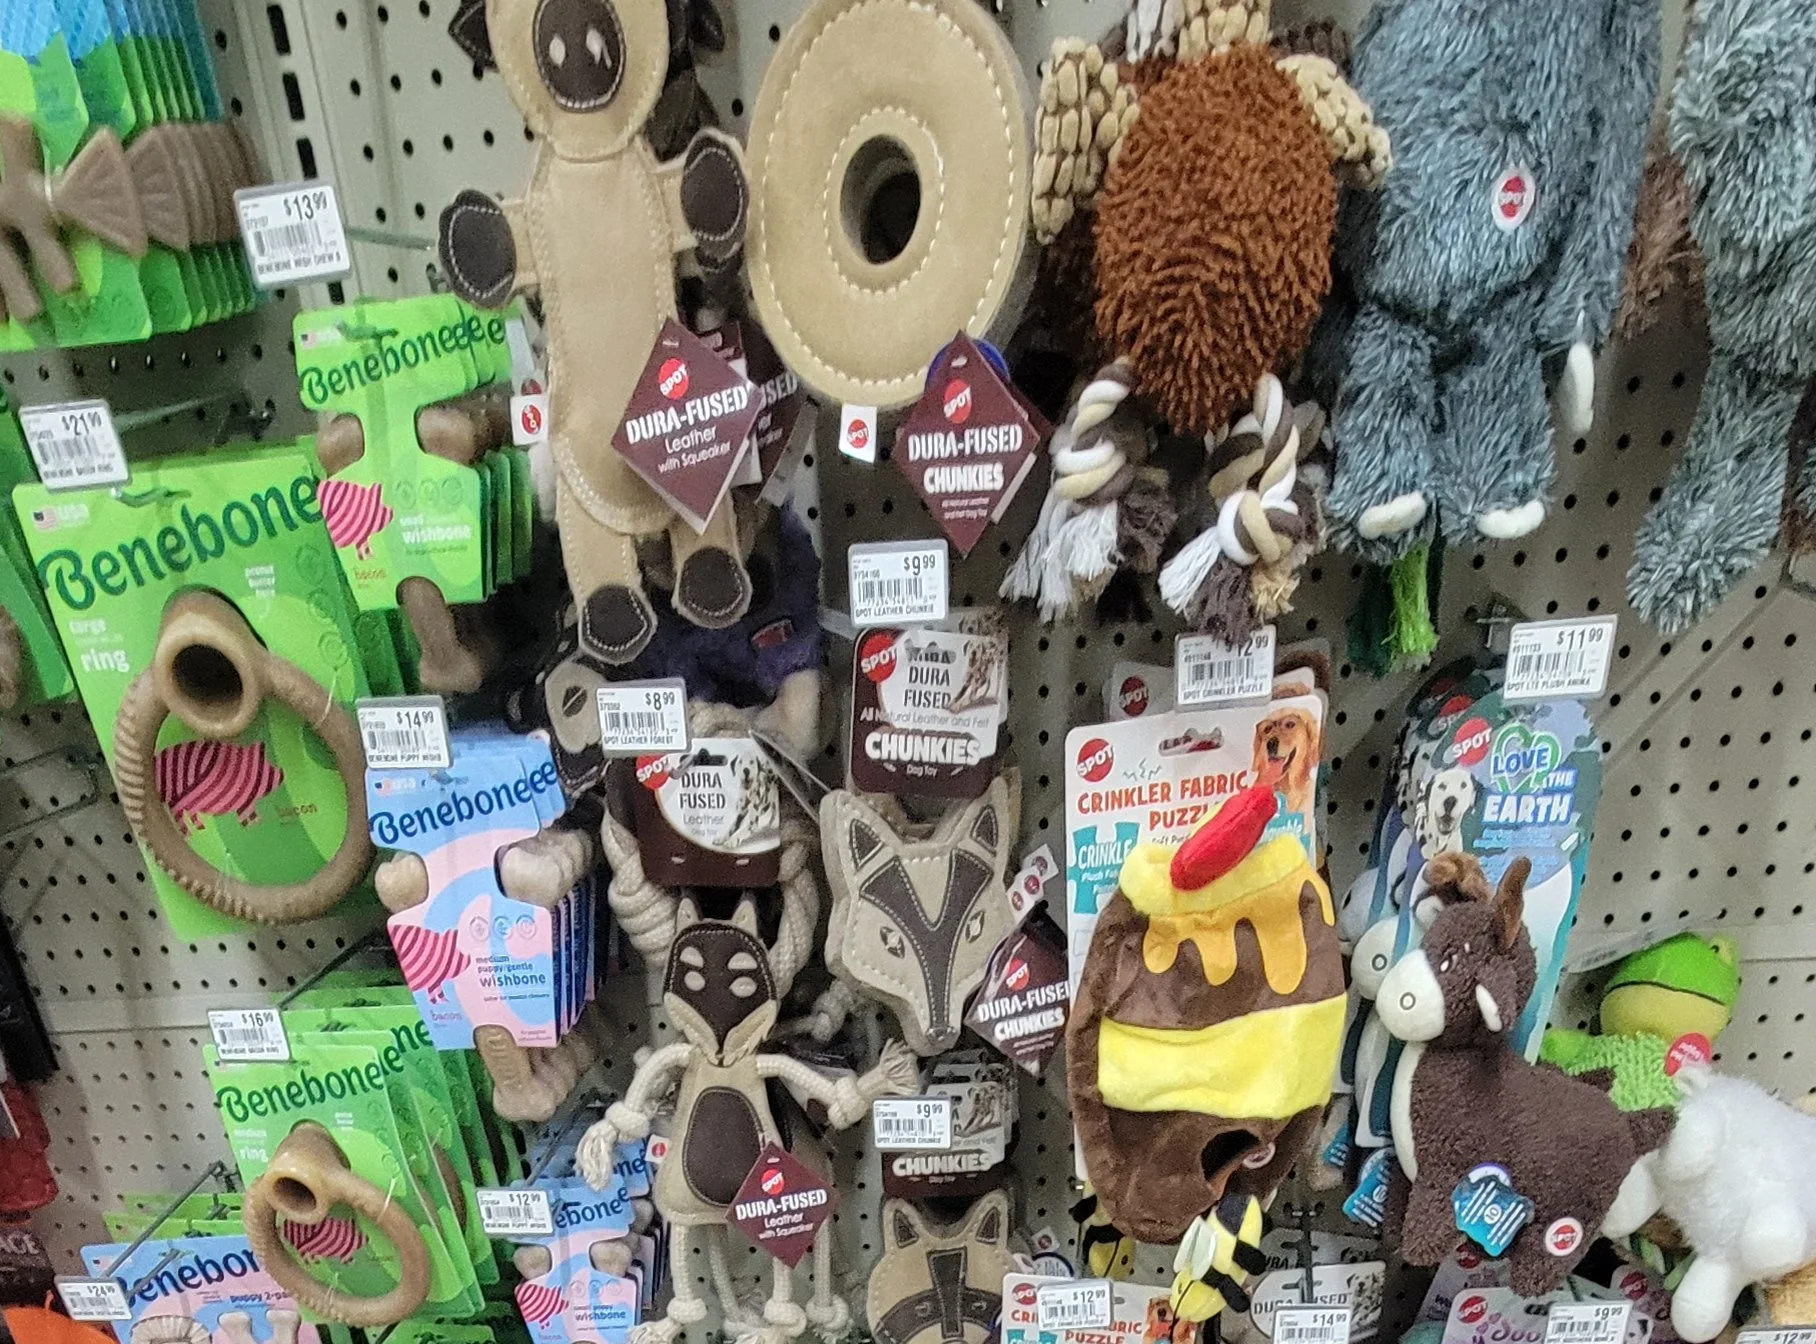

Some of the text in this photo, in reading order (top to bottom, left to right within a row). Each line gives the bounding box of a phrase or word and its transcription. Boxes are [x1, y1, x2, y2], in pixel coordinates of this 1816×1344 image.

[659, 364, 688, 395] SPOT
[625, 385, 749, 444] DURA-FUSED
[944, 386, 972, 418] SPOT
[665, 426, 717, 454] Leather
[847, 427, 870, 443] SPOT
[907, 424, 1023, 461] DURA-FUSED
[658, 441, 731, 474] with Squeaker
[923, 463, 1004, 493] CHUNKIES
[37, 475, 323, 611] Benebone
[402, 525, 472, 545] wishbone
[856, 607, 871, 618] SPOT
[874, 606, 903, 617] LEATHER
[81, 649, 130, 673] ring
[860, 648, 898, 673] SPOT
[908, 666, 950, 686] DURA
[904, 689, 951, 709] FUSED
[912, 711, 947, 725] Leather
[951, 714, 970, 726] and
[621, 735, 648, 745] LEATHER
[865, 731, 980, 765] CHUNKIES
[1452, 727, 1492, 758] SPOT
[636, 756, 671, 783] SPOT
[907, 764, 922, 776] Dog
[1077, 744, 1114, 776] SPOT
[1494, 747, 1550, 774] LOVE
[681, 772, 722, 788] DURA
[1548, 771, 1574, 787] THE
[679, 792, 725, 809] FUSED
[1077, 770, 1248, 815] CRINKLER FABRIC
[369, 778, 533, 847] Benebone
[683, 813, 725, 825] Leather
[1149, 803, 1209, 831] PUZZ
[1484, 793, 1571, 823] EARTH
[1078, 837, 1133, 869] CRINKLE
[479, 973, 546, 987] wishbone
[1006, 962, 1028, 988] SPOT
[994, 1006, 1065, 1041] CHUNKIES
[216, 1061, 384, 1123] Benebone
[240, 1147, 268, 1163] ring
[892, 1153, 989, 1177] CHUNKIES
[735, 1189, 828, 1220] DURA-FUSED
[764, 1213, 804, 1228] Leather
[575, 1311, 626, 1321] wishbone
[1457, 1301, 1488, 1319] SPOT
